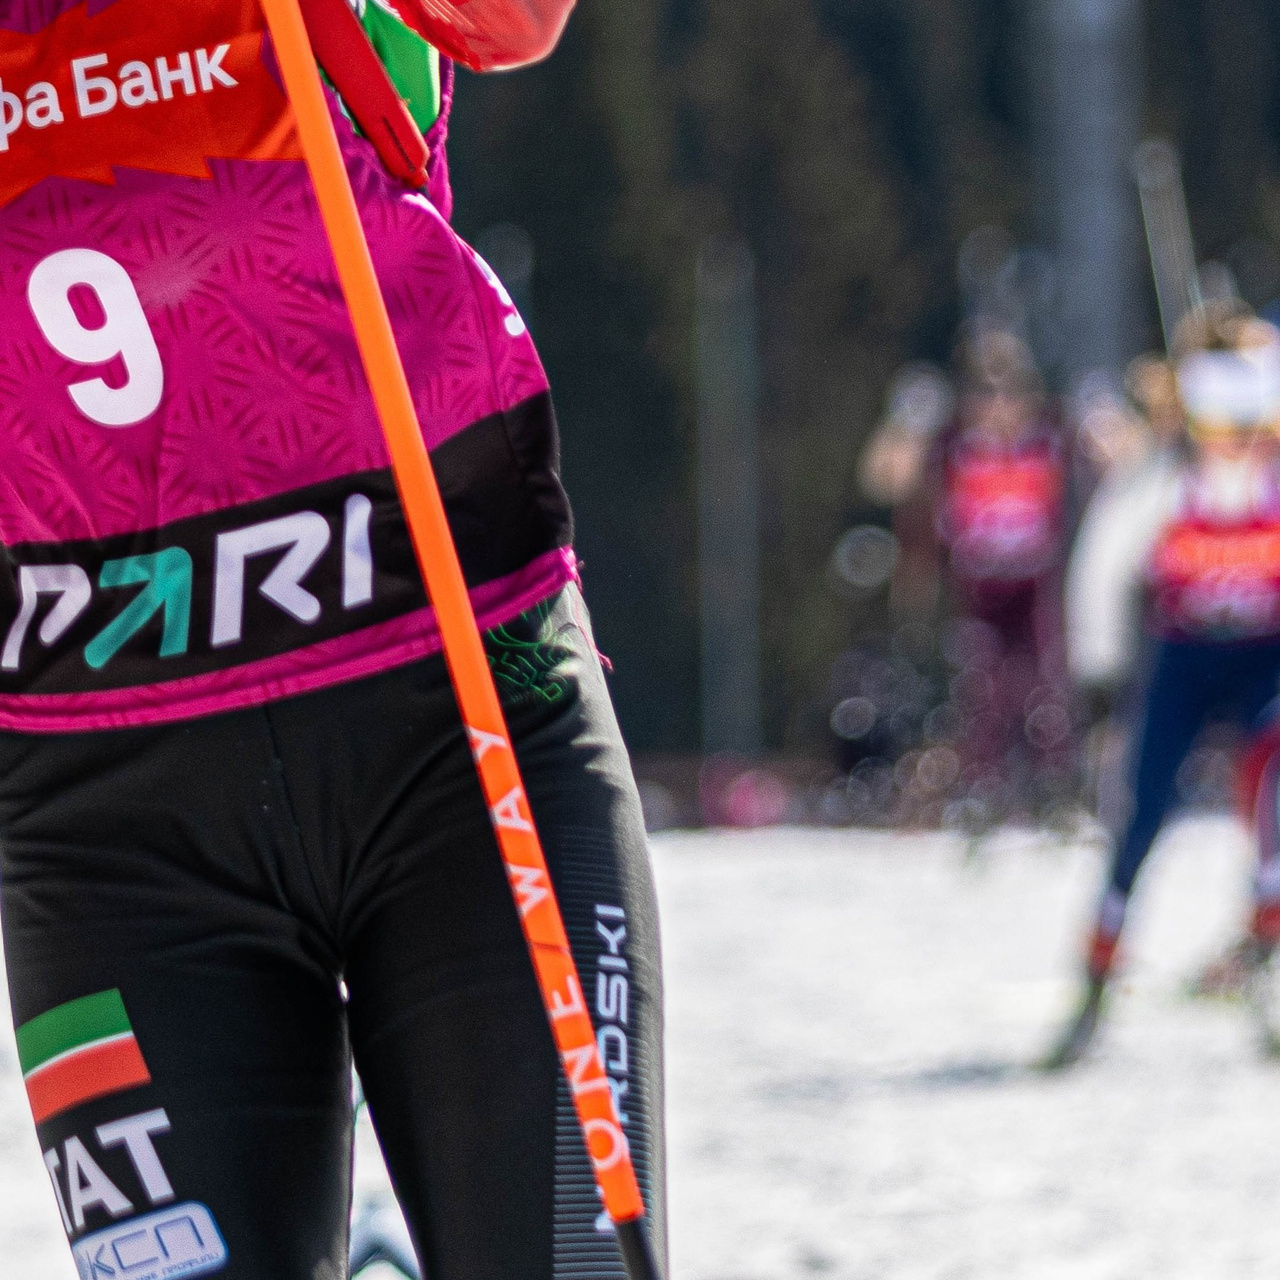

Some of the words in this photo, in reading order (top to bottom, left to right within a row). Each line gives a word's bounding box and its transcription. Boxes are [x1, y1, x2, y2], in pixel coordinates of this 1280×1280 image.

[69, 43, 239, 119] Банк
[26, 248, 165, 428] 9
[1, 493, 373, 671] PARI
